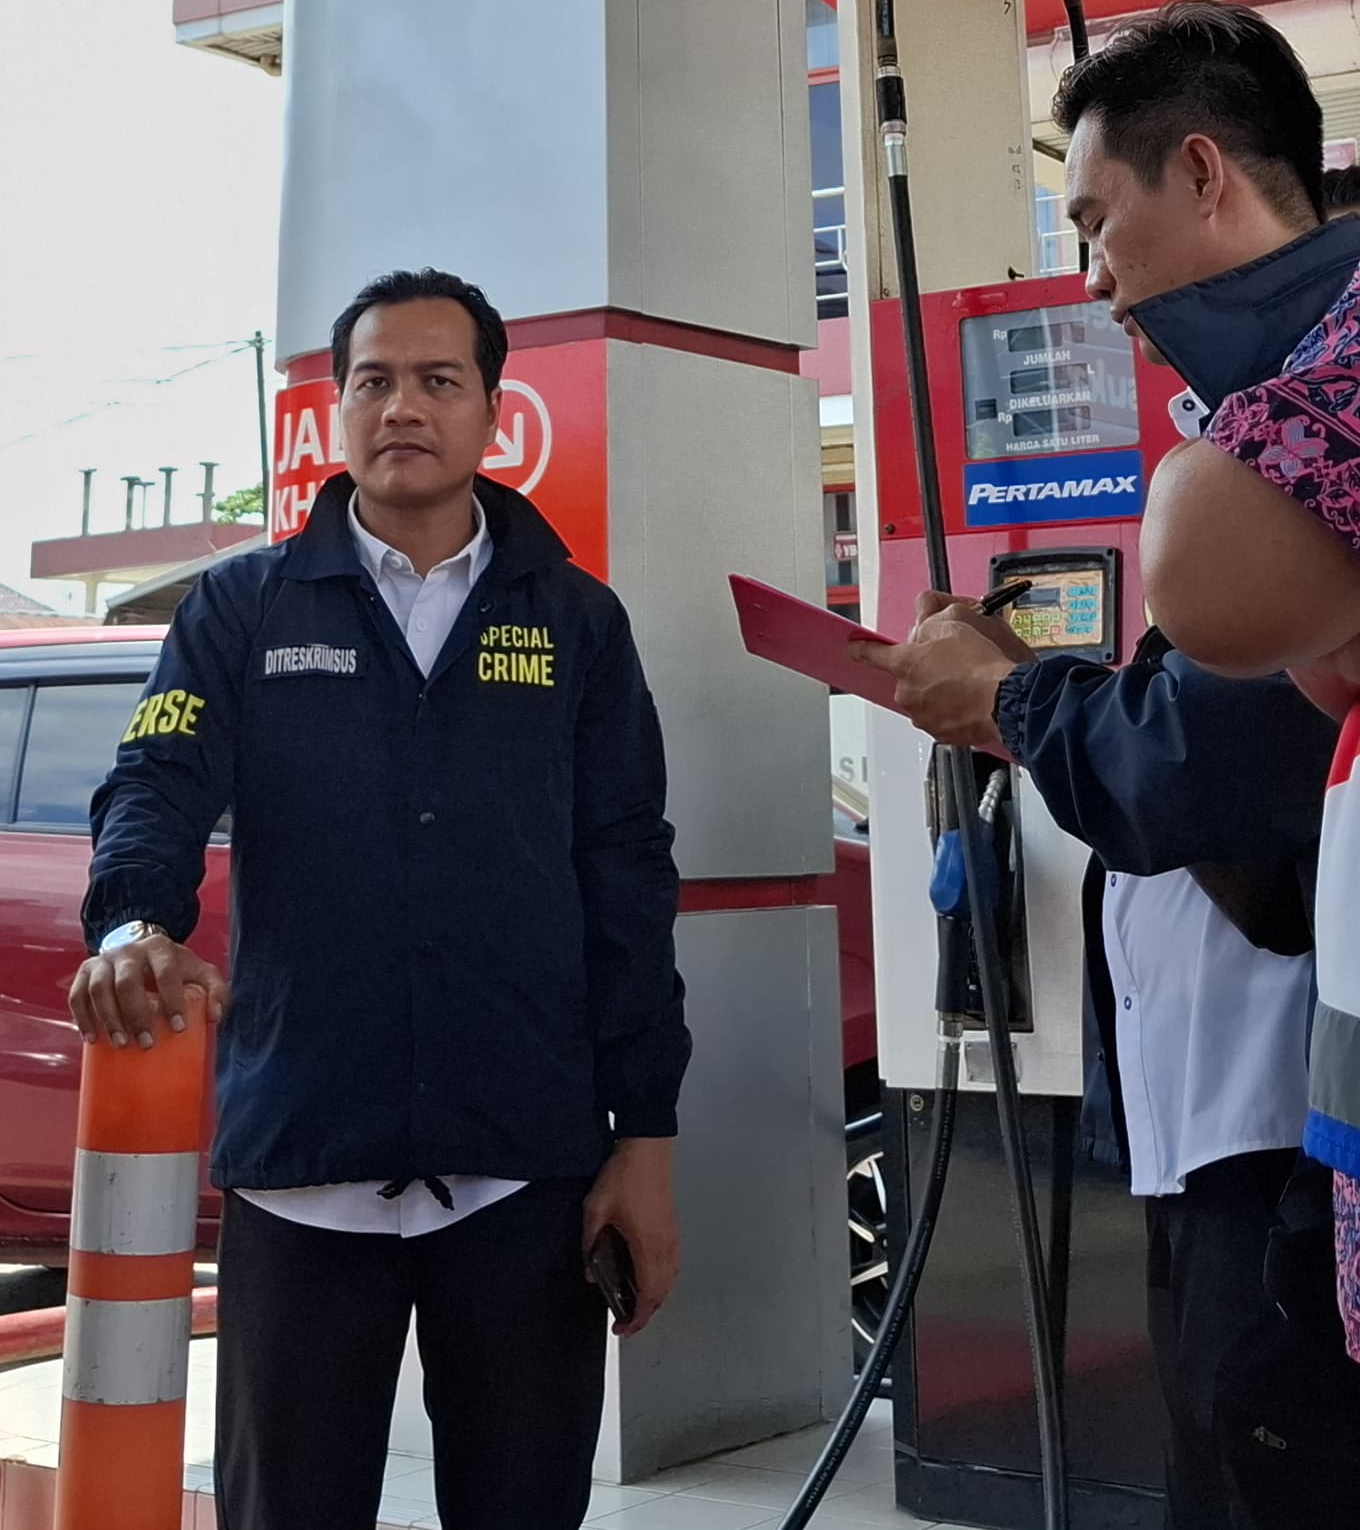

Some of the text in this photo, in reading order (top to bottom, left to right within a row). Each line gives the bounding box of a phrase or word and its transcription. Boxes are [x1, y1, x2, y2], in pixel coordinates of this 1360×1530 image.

[1023, 350, 1071, 366] JUMLAH
[1009, 390, 1091, 410] DIKELUARKAN
[1006, 434, 1100, 452] HARGA SATU LITER
[968, 475, 1137, 505] PERTAMAX
[265, 647, 357, 675] DITRESKRIMSUS
[478, 652, 554, 686] CRIME
